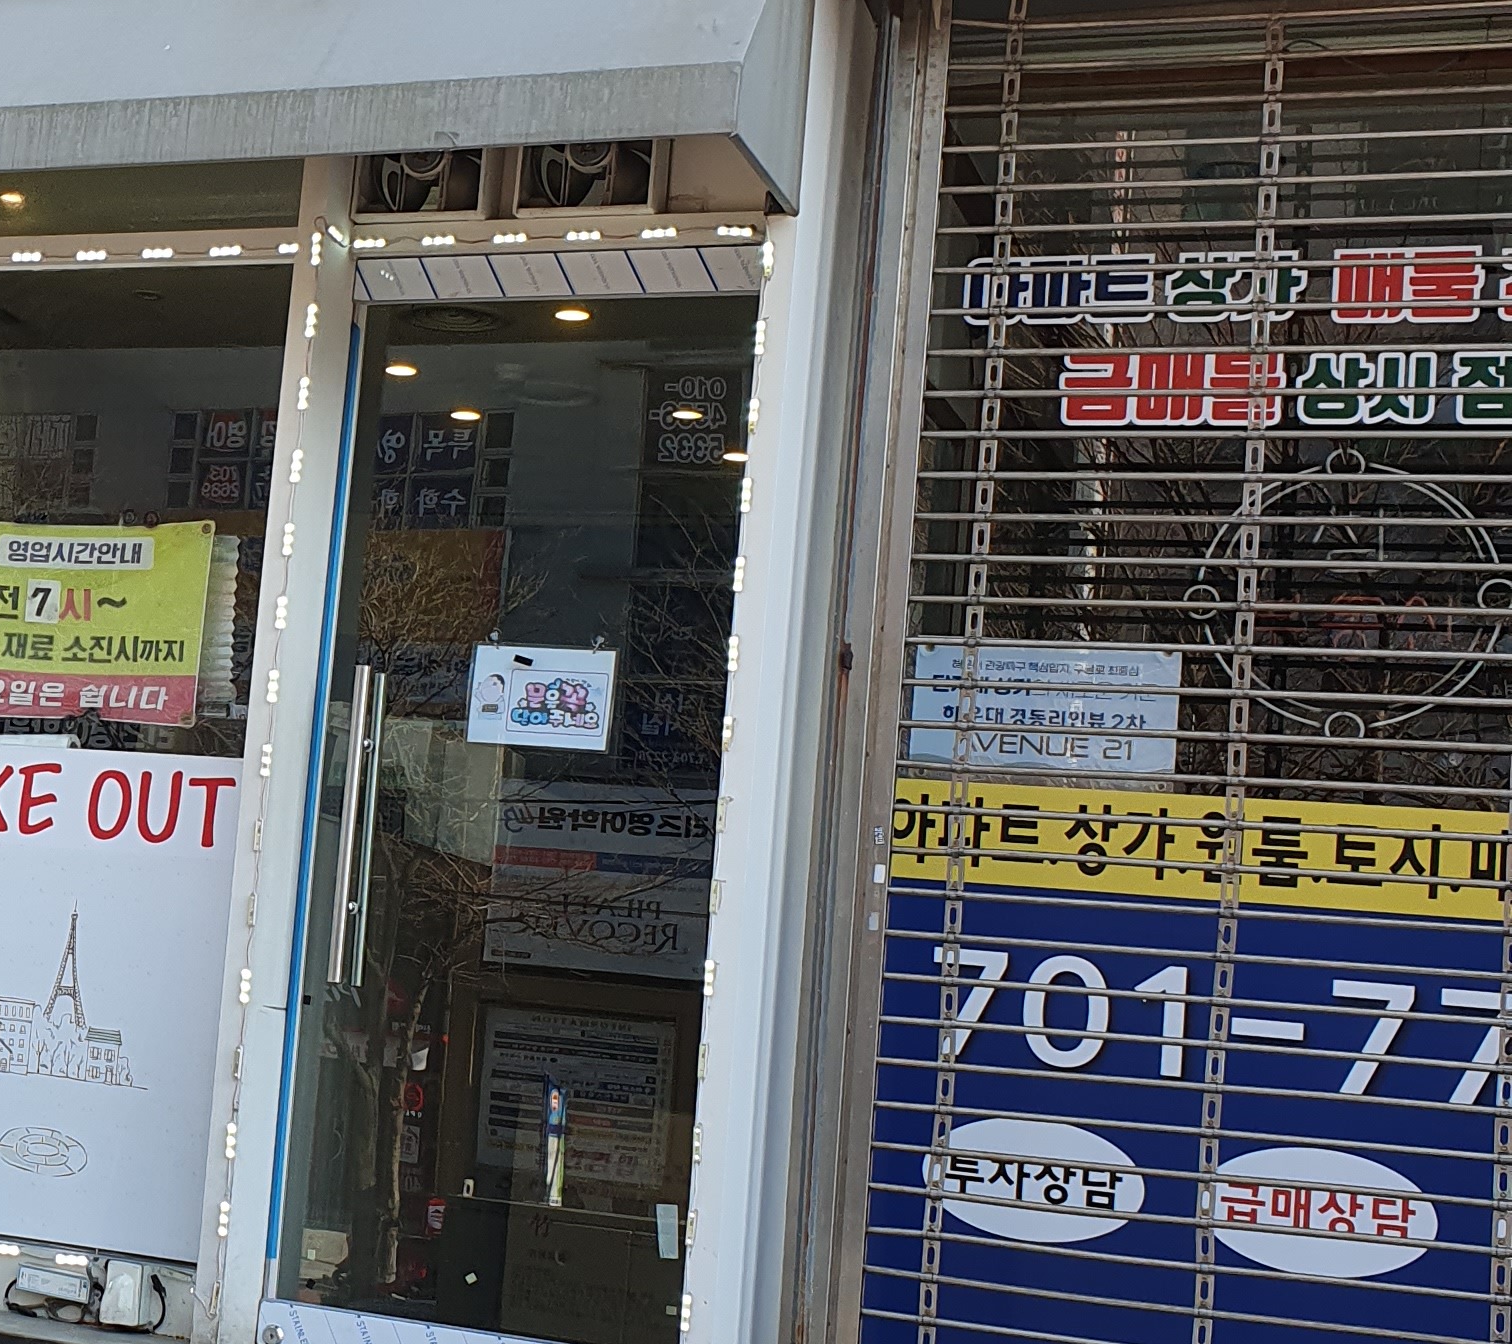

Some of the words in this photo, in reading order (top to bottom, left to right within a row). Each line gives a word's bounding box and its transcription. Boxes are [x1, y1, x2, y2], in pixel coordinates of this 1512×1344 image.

[1330, 245, 1486, 324] 매물
[1296, 352, 1436, 425] 상시
[7, 540, 143, 565] 영업시간안내
[1, 632, 55, 662] 재료
[61, 635, 185, 664] 소진시까지
[80, 683, 169, 711] 쉽니다
[1102, 738, 1133, 761] 21
[88, 769, 236, 848] OUT
